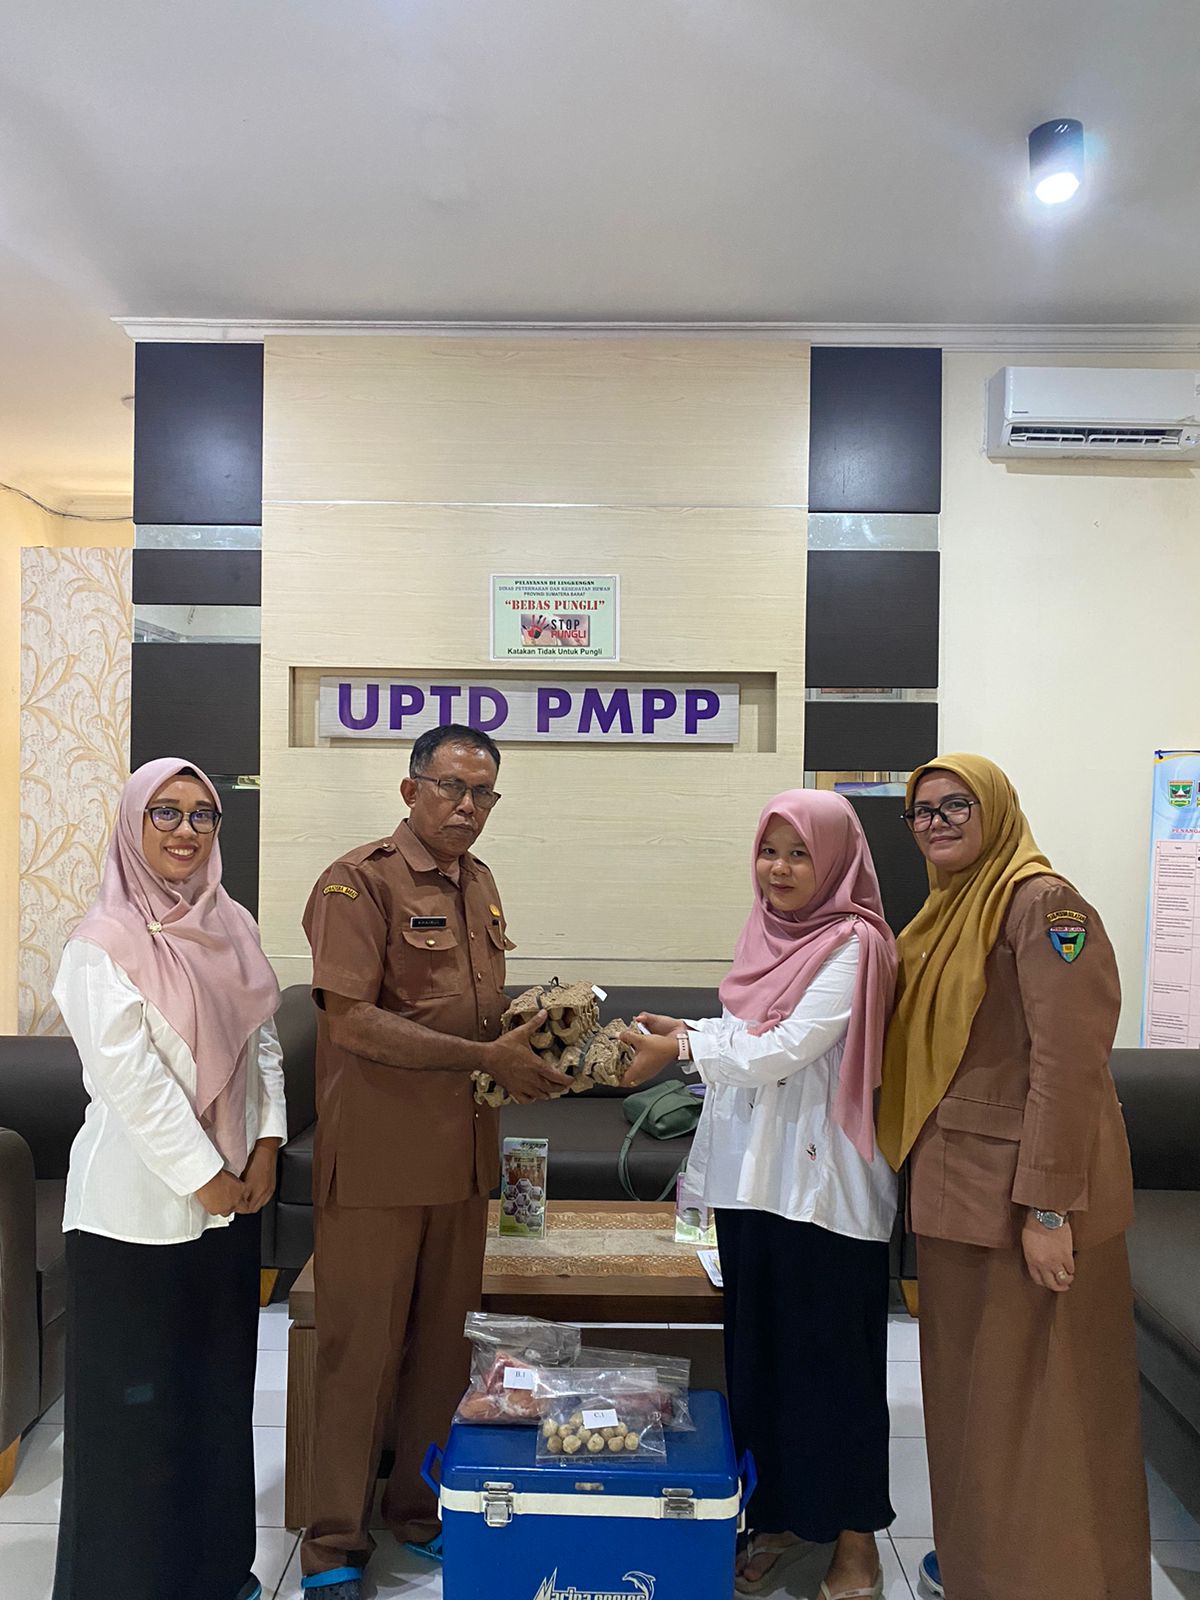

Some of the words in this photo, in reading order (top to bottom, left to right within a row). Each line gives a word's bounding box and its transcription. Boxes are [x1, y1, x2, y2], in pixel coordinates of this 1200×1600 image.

[551, 619, 580, 630] STOP
[551, 630, 586, 638] PUNGLI
[580, 648, 603, 657] Pungli
[338, 683, 509, 733] UPTD
[537, 687, 721, 735] PMPP
